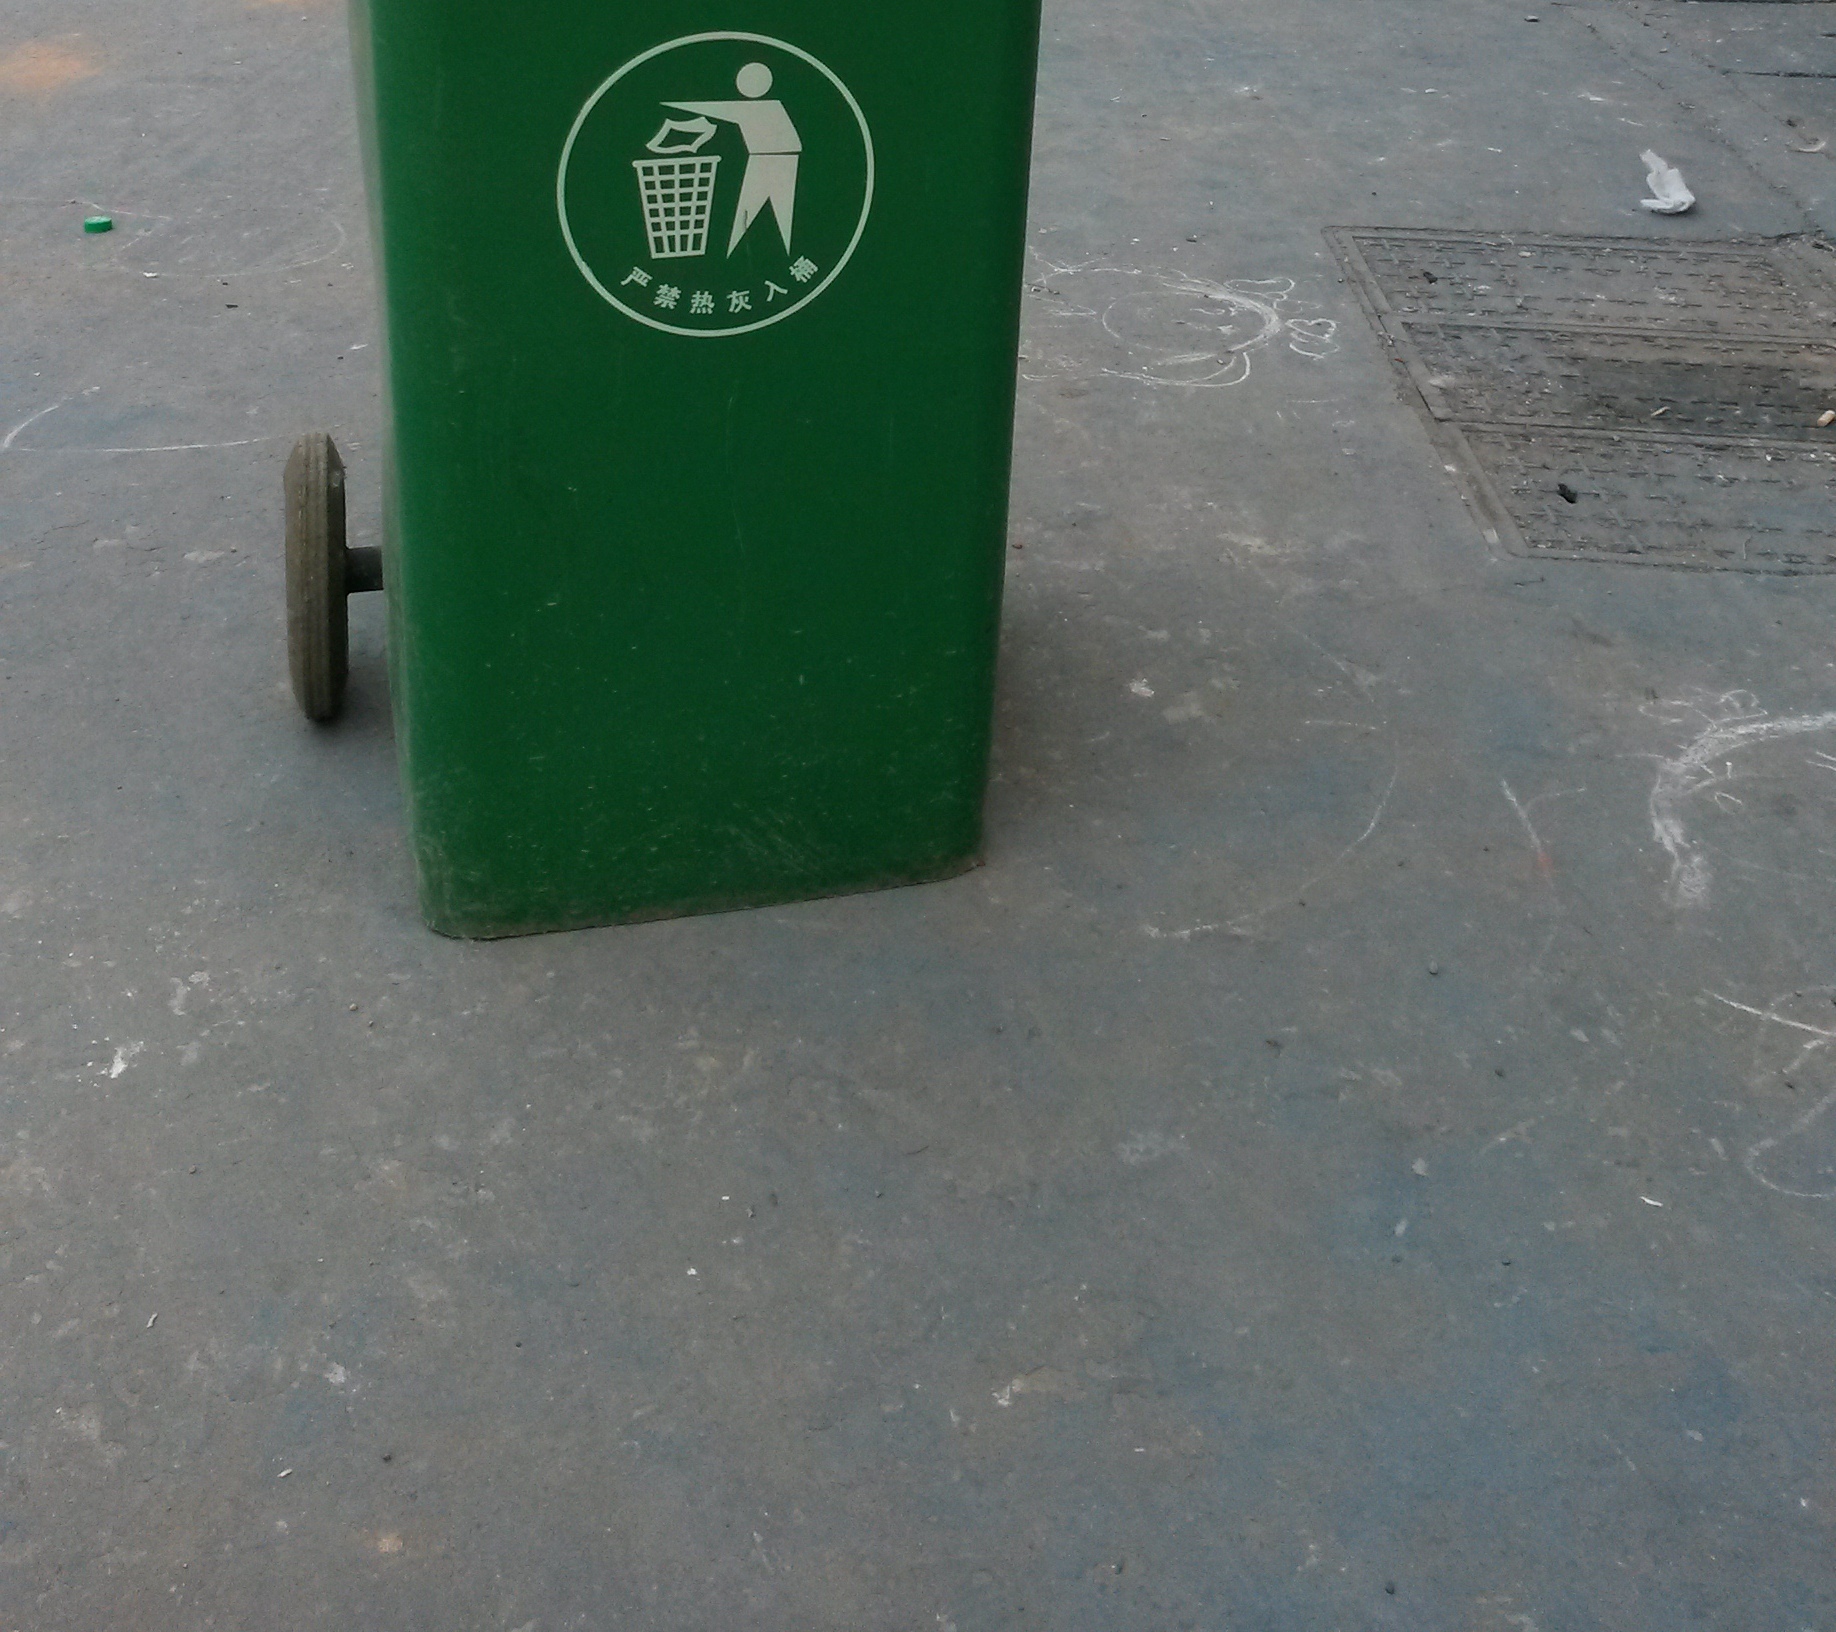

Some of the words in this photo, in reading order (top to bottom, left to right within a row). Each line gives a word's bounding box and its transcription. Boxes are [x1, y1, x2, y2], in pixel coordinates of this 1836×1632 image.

[620, 255, 819, 314] 严禁热灰入桶
